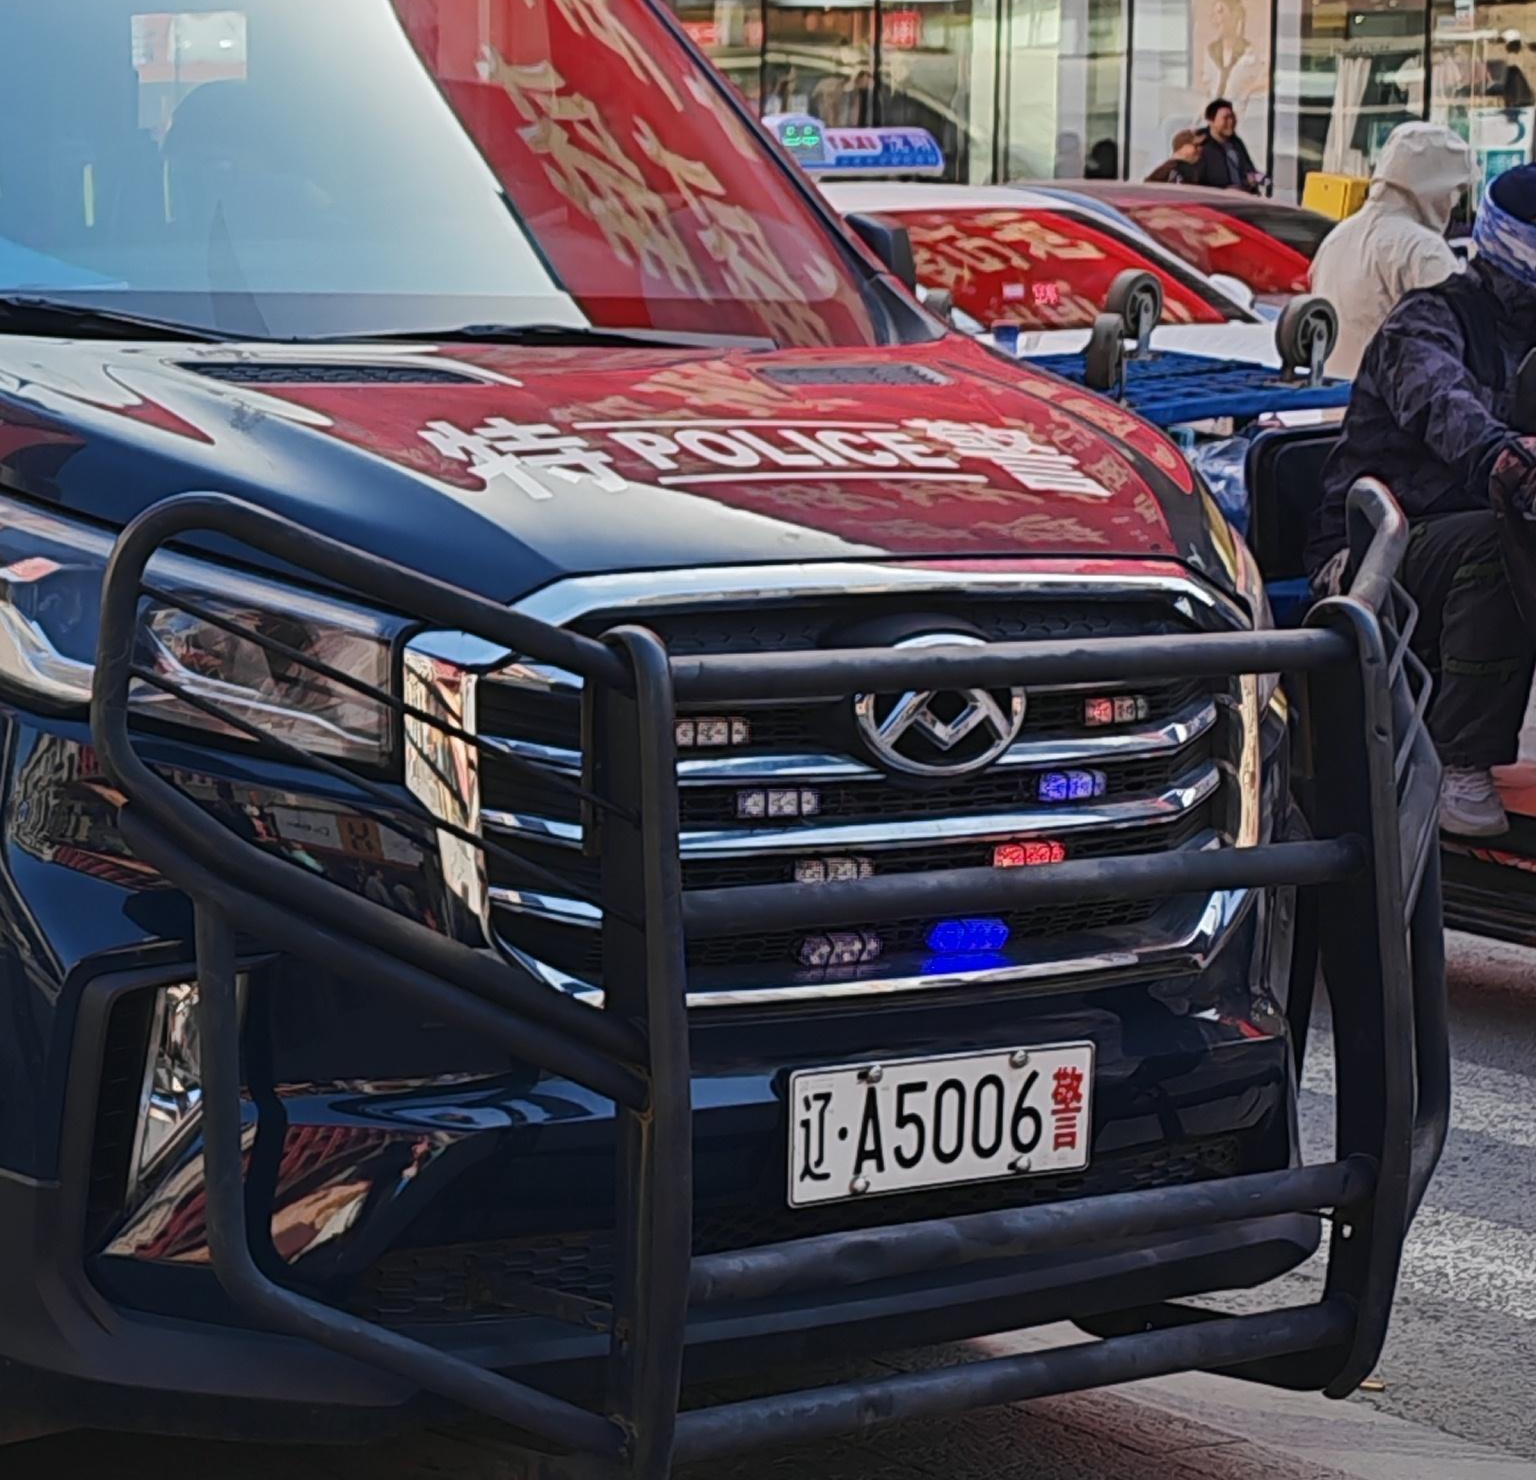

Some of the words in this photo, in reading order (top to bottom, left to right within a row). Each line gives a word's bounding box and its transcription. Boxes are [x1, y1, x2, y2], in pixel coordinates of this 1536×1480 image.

[417, 417, 629, 500] 特
[607, 431, 960, 469] POLICE
[901, 418, 1112, 497] 警
